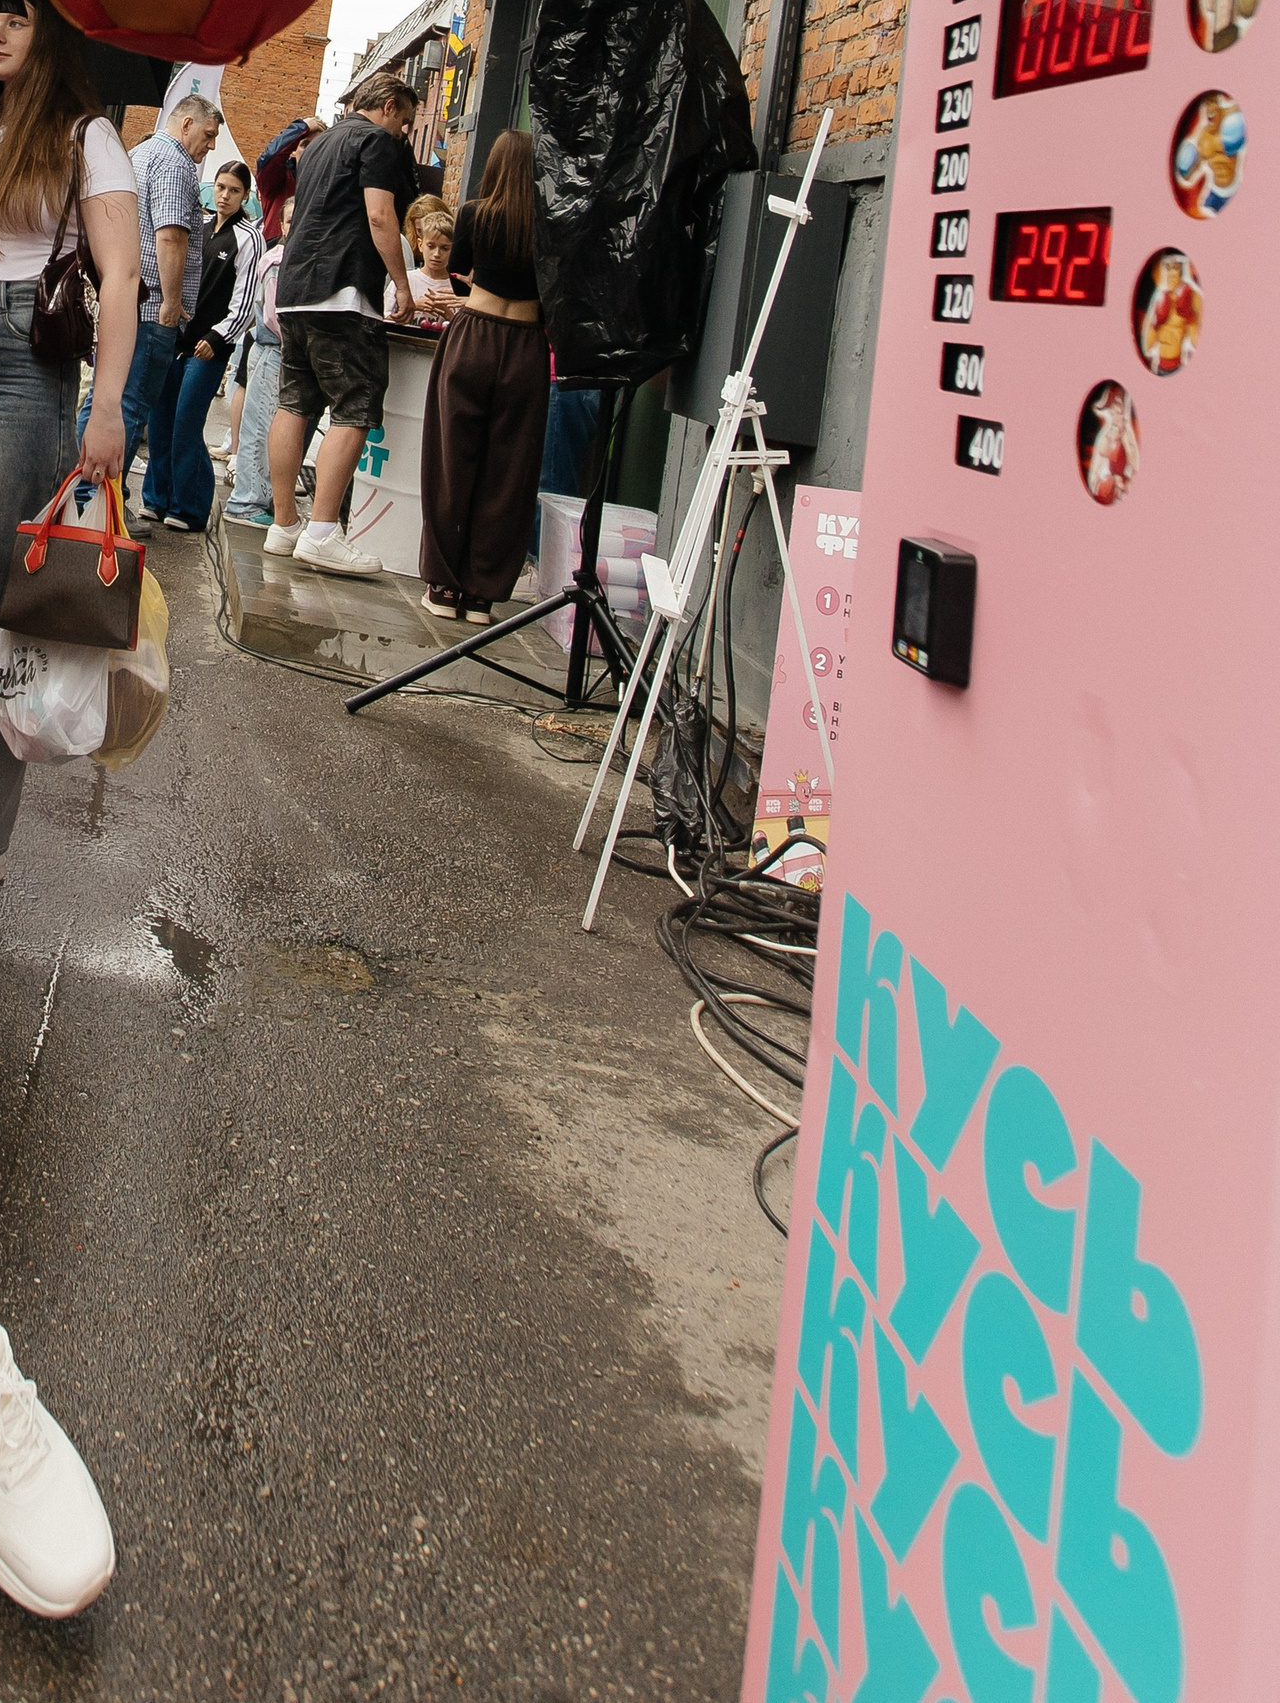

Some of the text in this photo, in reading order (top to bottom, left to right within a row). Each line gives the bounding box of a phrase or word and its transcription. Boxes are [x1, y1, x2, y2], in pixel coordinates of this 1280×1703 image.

[948, 22, 980, 61] 250
[941, 87, 972, 124] 230
[937, 152, 969, 188] 200
[937, 217, 969, 251] 160
[941, 284, 974, 320] 120
[968, 426, 1004, 469] 400
[823, 592, 831, 609] 1
[814, 653, 827, 671] 2
[834, 891, 1204, 1458] КУСЬ
